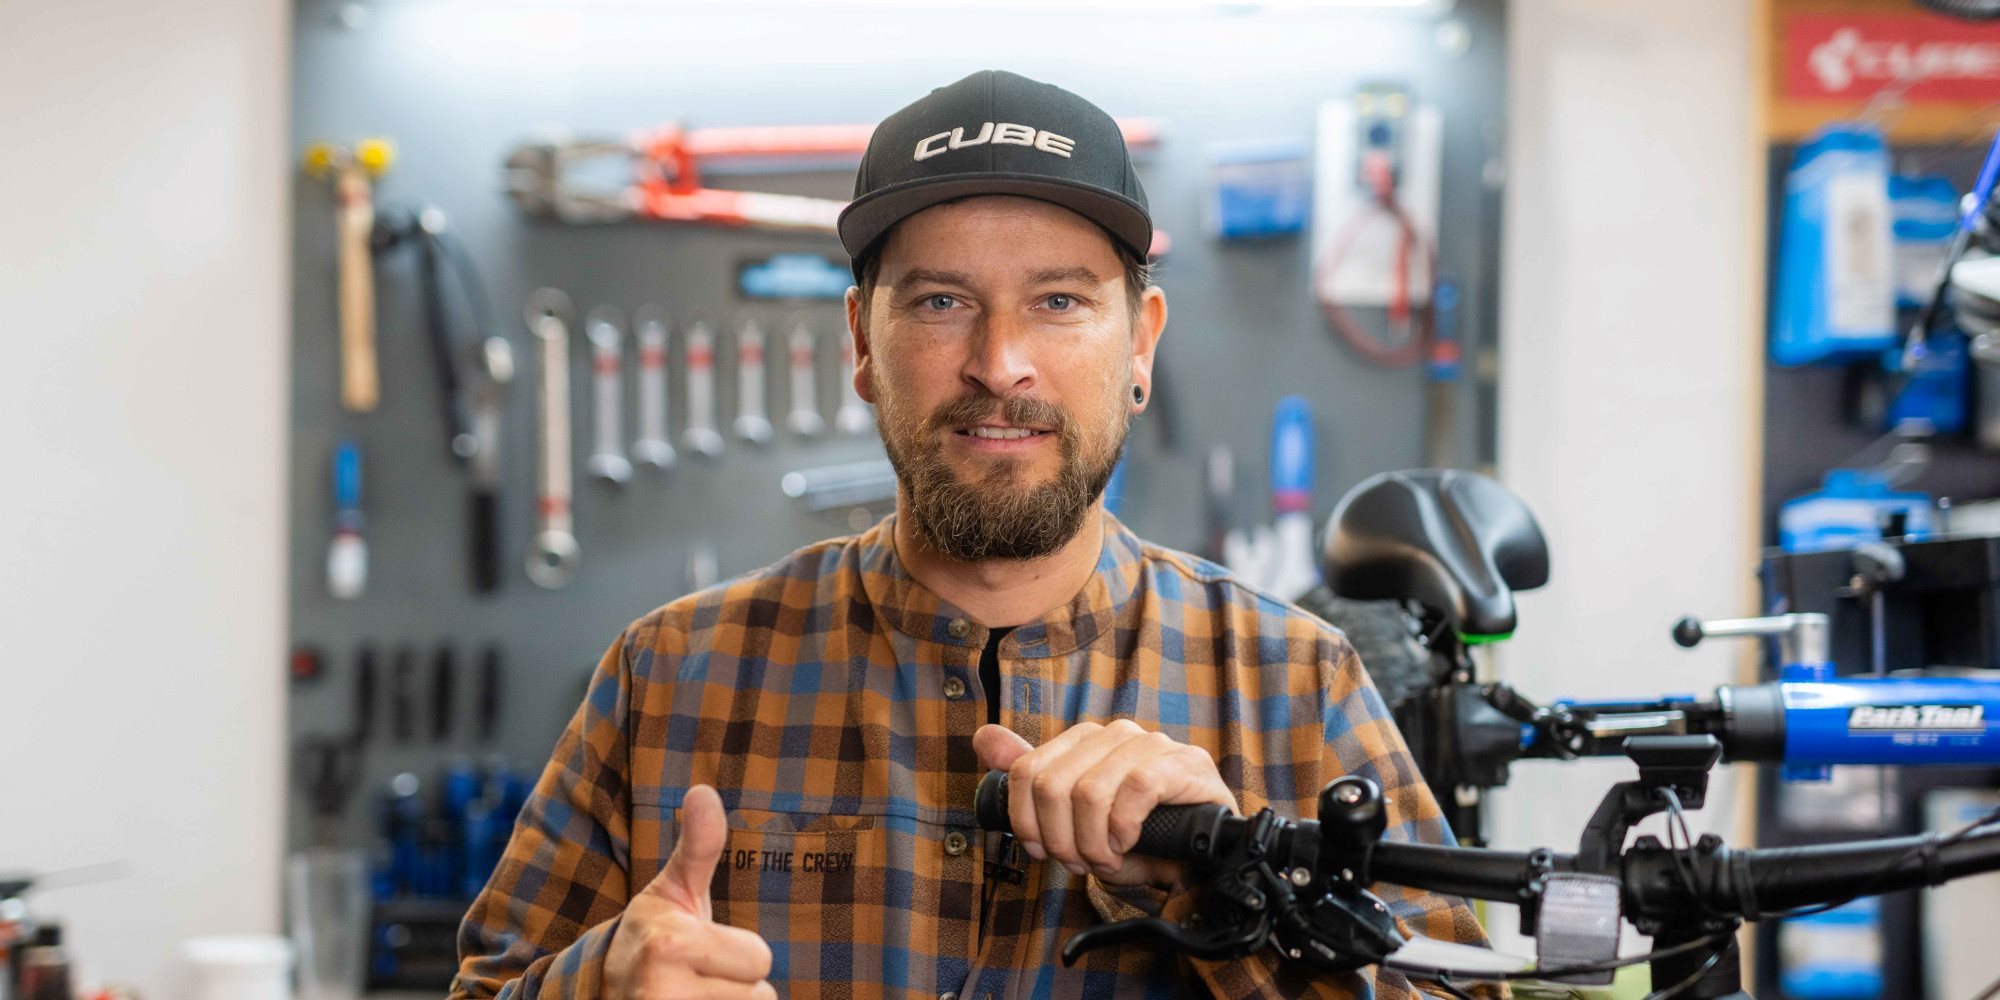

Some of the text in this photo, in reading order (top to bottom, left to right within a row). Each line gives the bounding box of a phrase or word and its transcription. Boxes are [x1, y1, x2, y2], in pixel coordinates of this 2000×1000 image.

[913, 121, 1076, 162] CUBE
[735, 849, 757, 870] OF
[762, 850, 794, 873] THE
[802, 851, 854, 873] CREW
